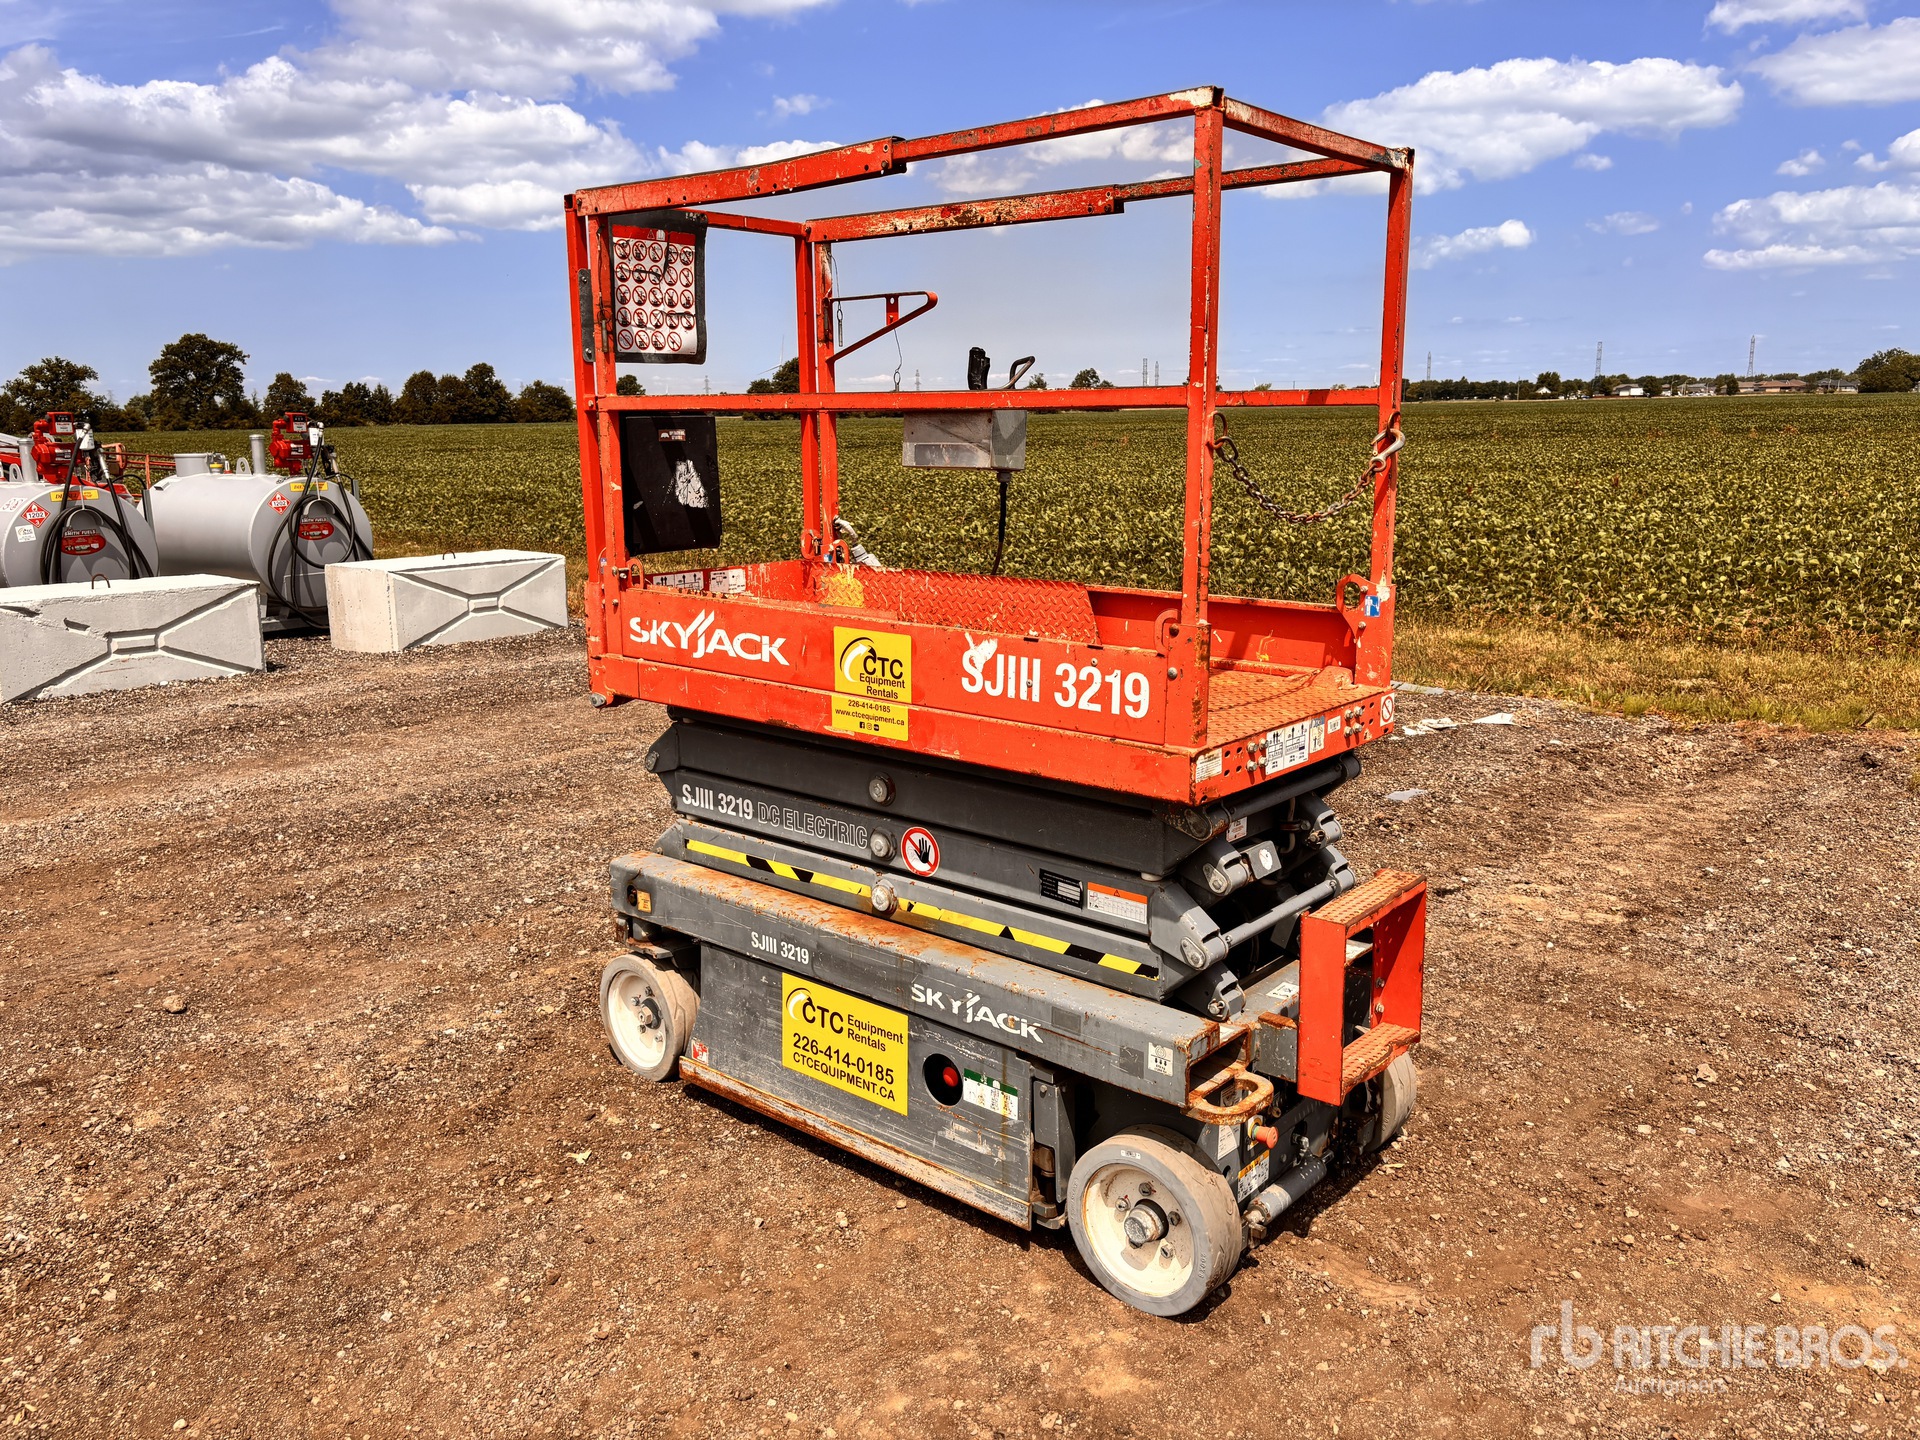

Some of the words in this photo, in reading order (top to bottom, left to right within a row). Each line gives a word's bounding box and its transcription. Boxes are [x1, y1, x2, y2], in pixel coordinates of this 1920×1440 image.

[629, 609, 790, 666] SKYJACK
[859, 672, 906, 689] Equipment
[863, 655, 904, 680] CTC
[848, 699, 891, 713] 226-414-0185
[866, 685, 899, 700] Rentals
[1053, 662, 1150, 719] 3219
[835, 708, 905, 726] www.ctcequipment.ca
[682, 784, 714, 811] SJIII
[717, 793, 753, 820] 3219
[758, 802, 780, 828] DC
[783, 808, 868, 849] ELECTRIC
[751, 931, 777, 955] SJIII
[780, 941, 809, 965] 3219
[802, 1000, 844, 1034] CTC
[847, 1014, 904, 1045] Equipment
[911, 983, 1044, 1044] SKYJACK
[847, 1027, 886, 1052] Rentals
[793, 1032, 894, 1085] 226-414-0185
[793, 1051, 896, 1102] CTCEQUIPMENT.CA
